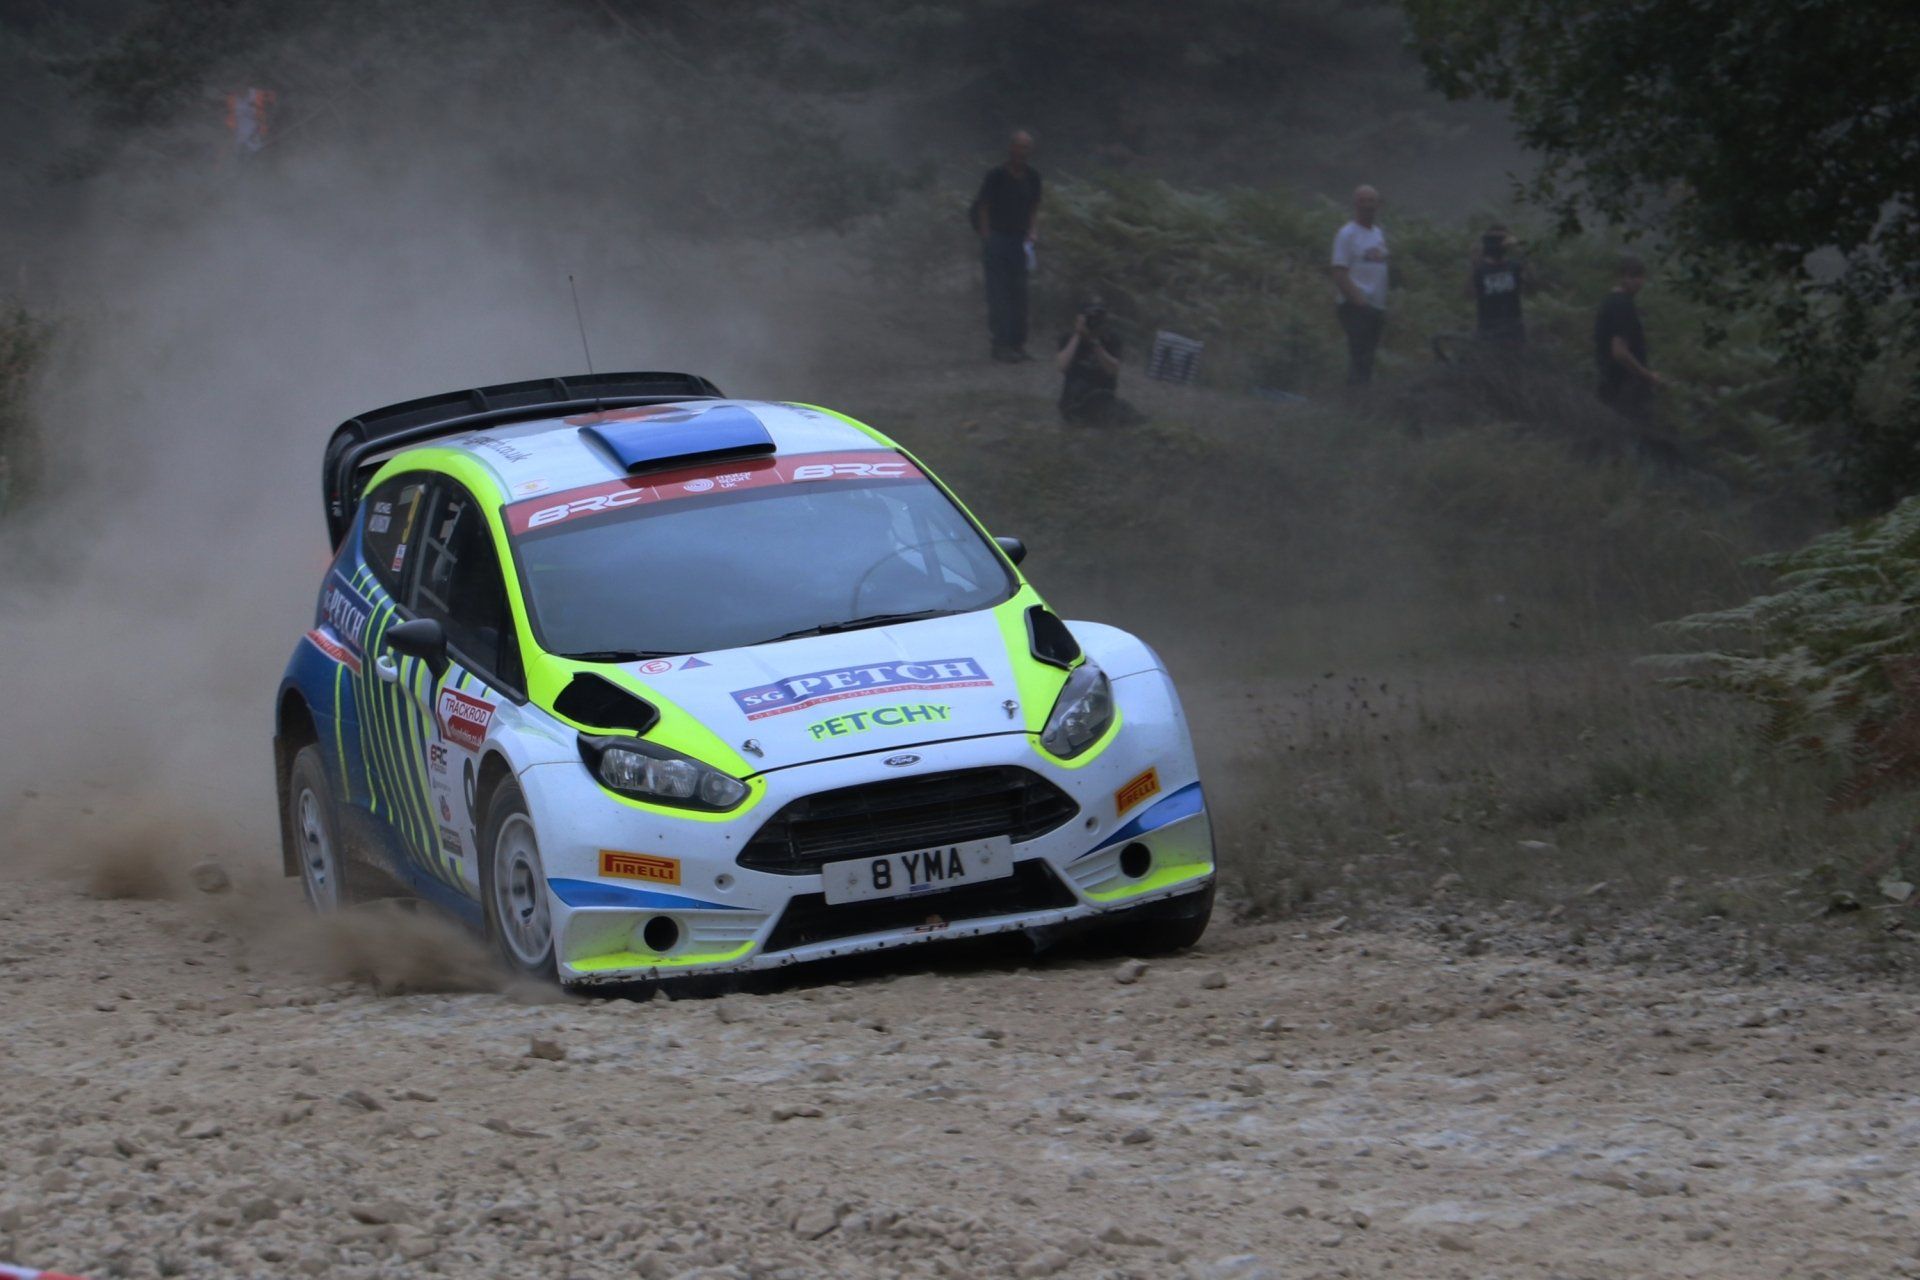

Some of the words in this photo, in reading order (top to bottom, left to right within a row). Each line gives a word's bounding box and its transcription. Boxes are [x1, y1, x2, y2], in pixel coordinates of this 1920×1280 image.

[793, 462, 907, 480] BRC
[528, 488, 644, 528] BRC
[330, 588, 366, 643] PETCH
[743, 690, 785, 707] SG
[784, 661, 981, 699] PETCH
[445, 697, 487, 724] TRACKROD
[808, 704, 951, 739] PETCHY
[1118, 772, 1156, 811] PIRELLI
[604, 853, 674, 880] PIRELLI
[872, 858, 892, 890] 8
[901, 847, 966, 885] YMA
